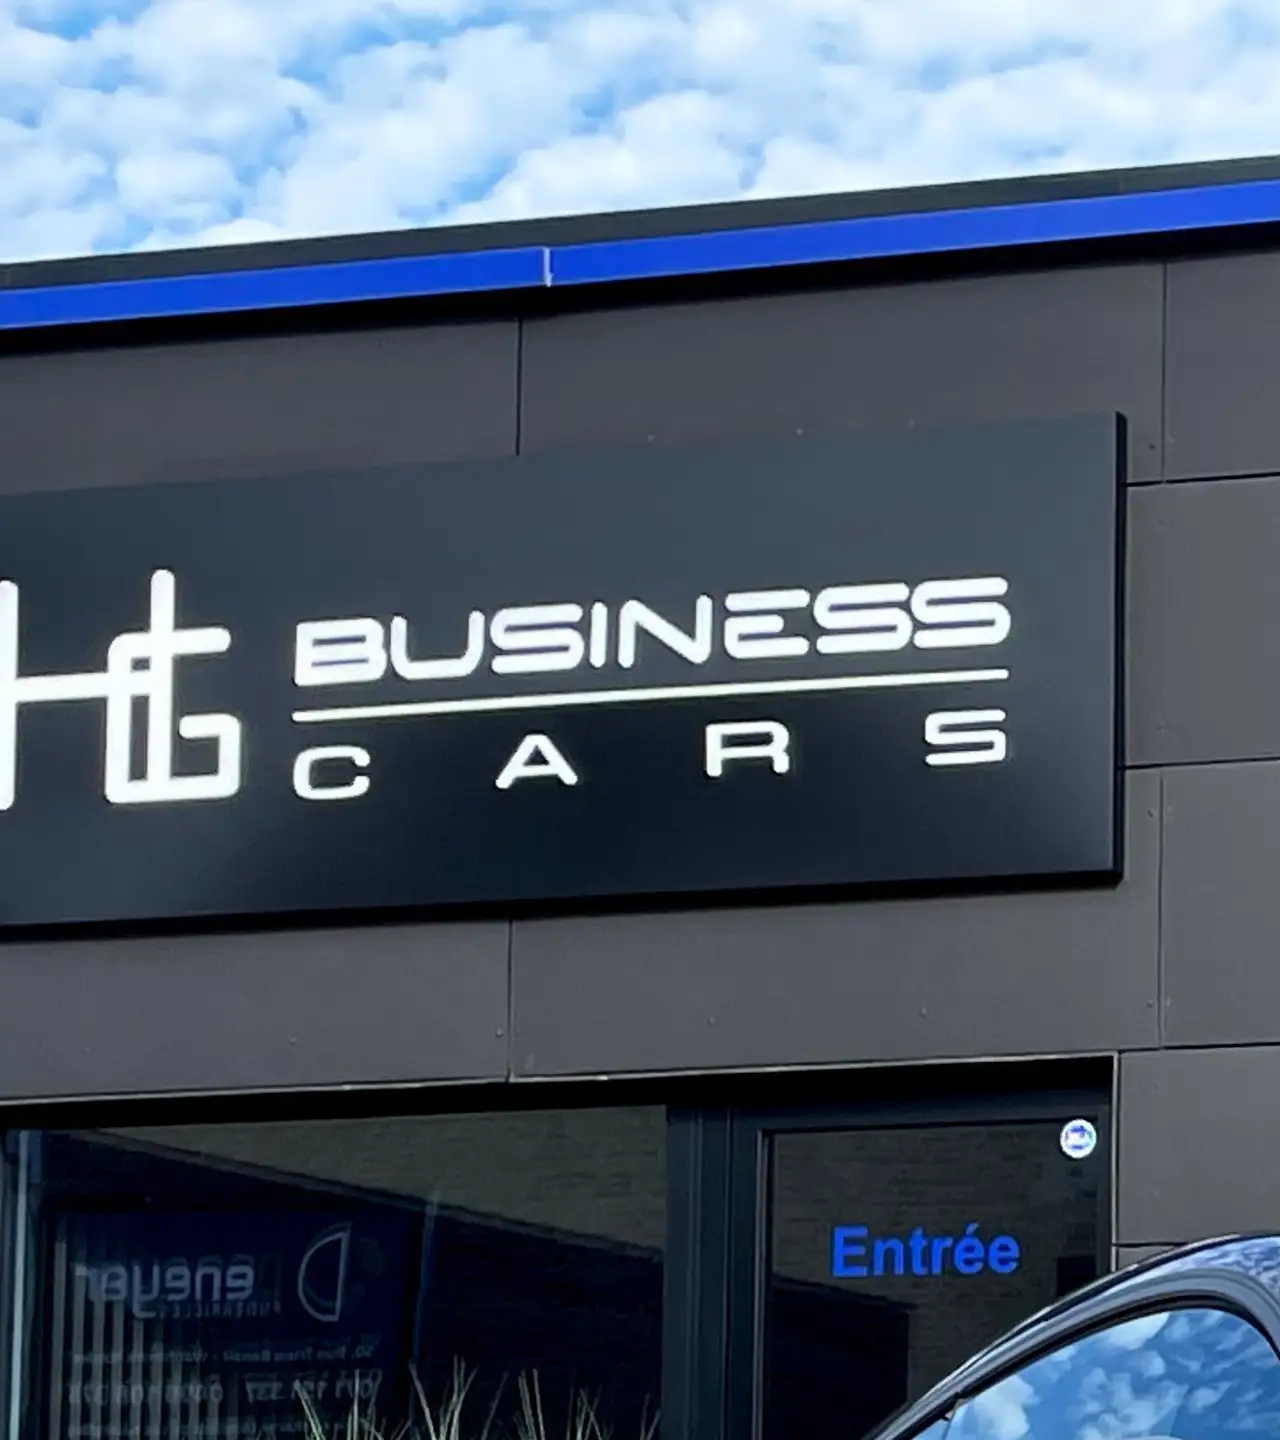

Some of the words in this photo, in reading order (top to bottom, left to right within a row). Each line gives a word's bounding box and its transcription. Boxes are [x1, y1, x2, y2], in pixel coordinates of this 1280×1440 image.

[293, 575, 1012, 687] BUSINESS
[292, 708, 1007, 801] CARS
[833, 1222, 1021, 1277] Entrée
